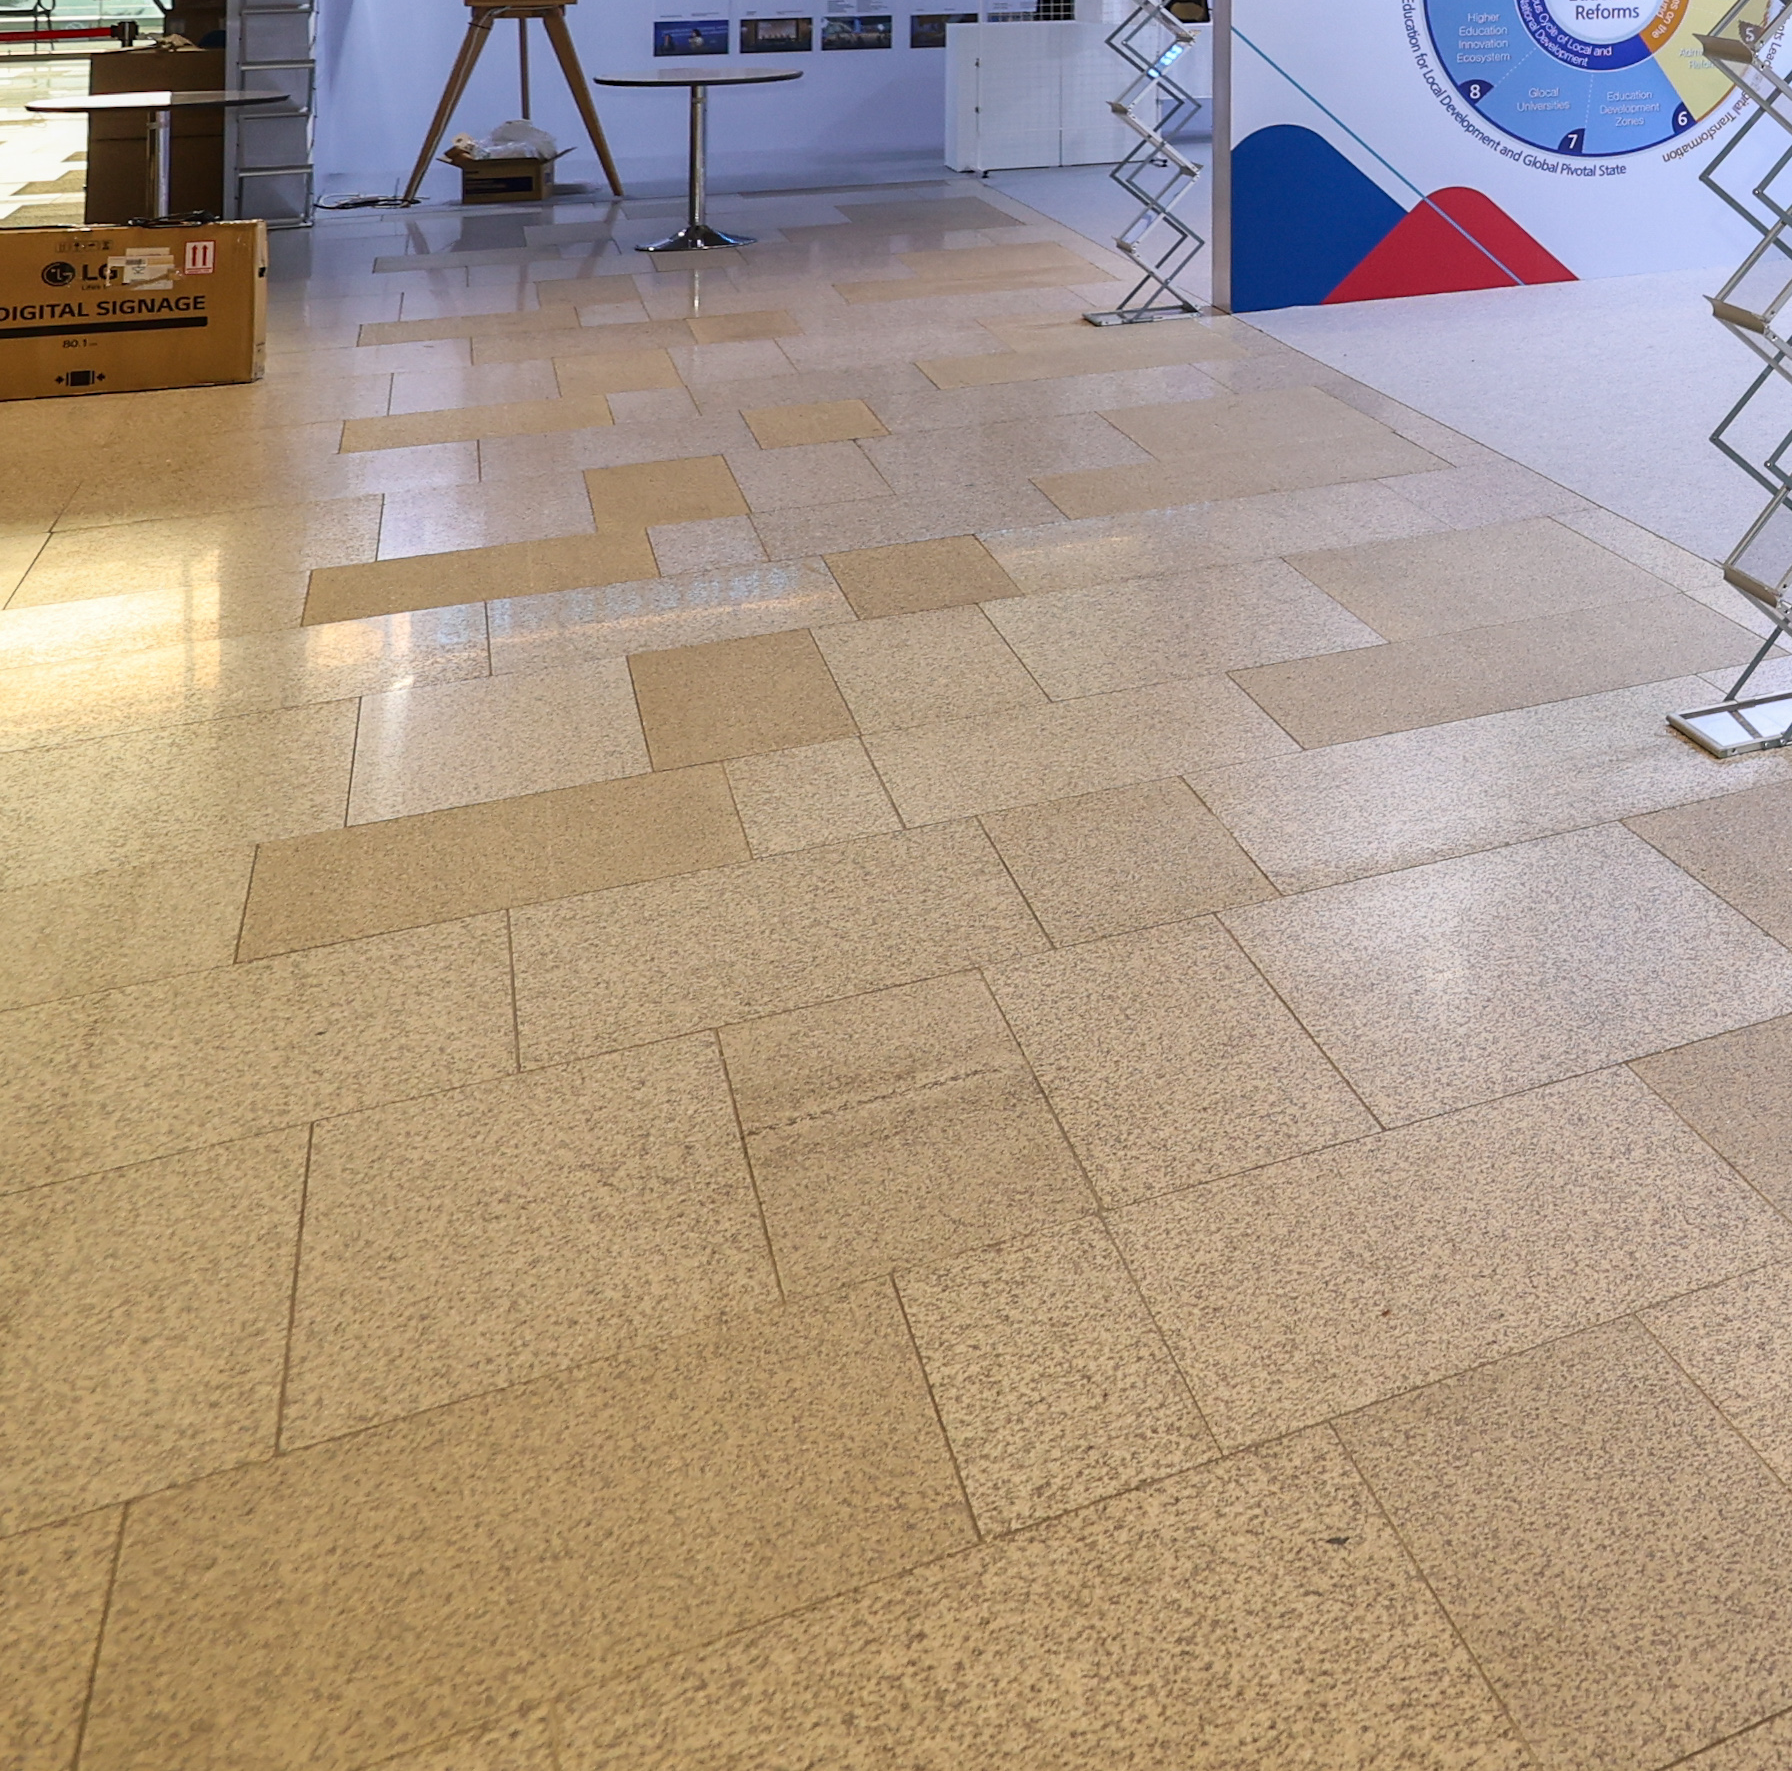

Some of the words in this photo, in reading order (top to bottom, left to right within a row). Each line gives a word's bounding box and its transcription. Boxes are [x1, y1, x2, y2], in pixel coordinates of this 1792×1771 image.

[1467, 12, 1501, 24] Higher
[1575, 5, 1640, 20] Reforms
[1458, 25, 1508, 36] Education
[1458, 39, 1510, 50] Innovation
[1456, 52, 1512, 64] Ecosystem
[1469, 84, 1482, 101] 8
[1606, 90, 1654, 103] Education
[1677, 111, 1688, 126] 6
[1568, 133, 1578, 149] 7
[0, 302, 90, 322] DIGITAL
[96, 295, 206, 316] SIGNAGE
